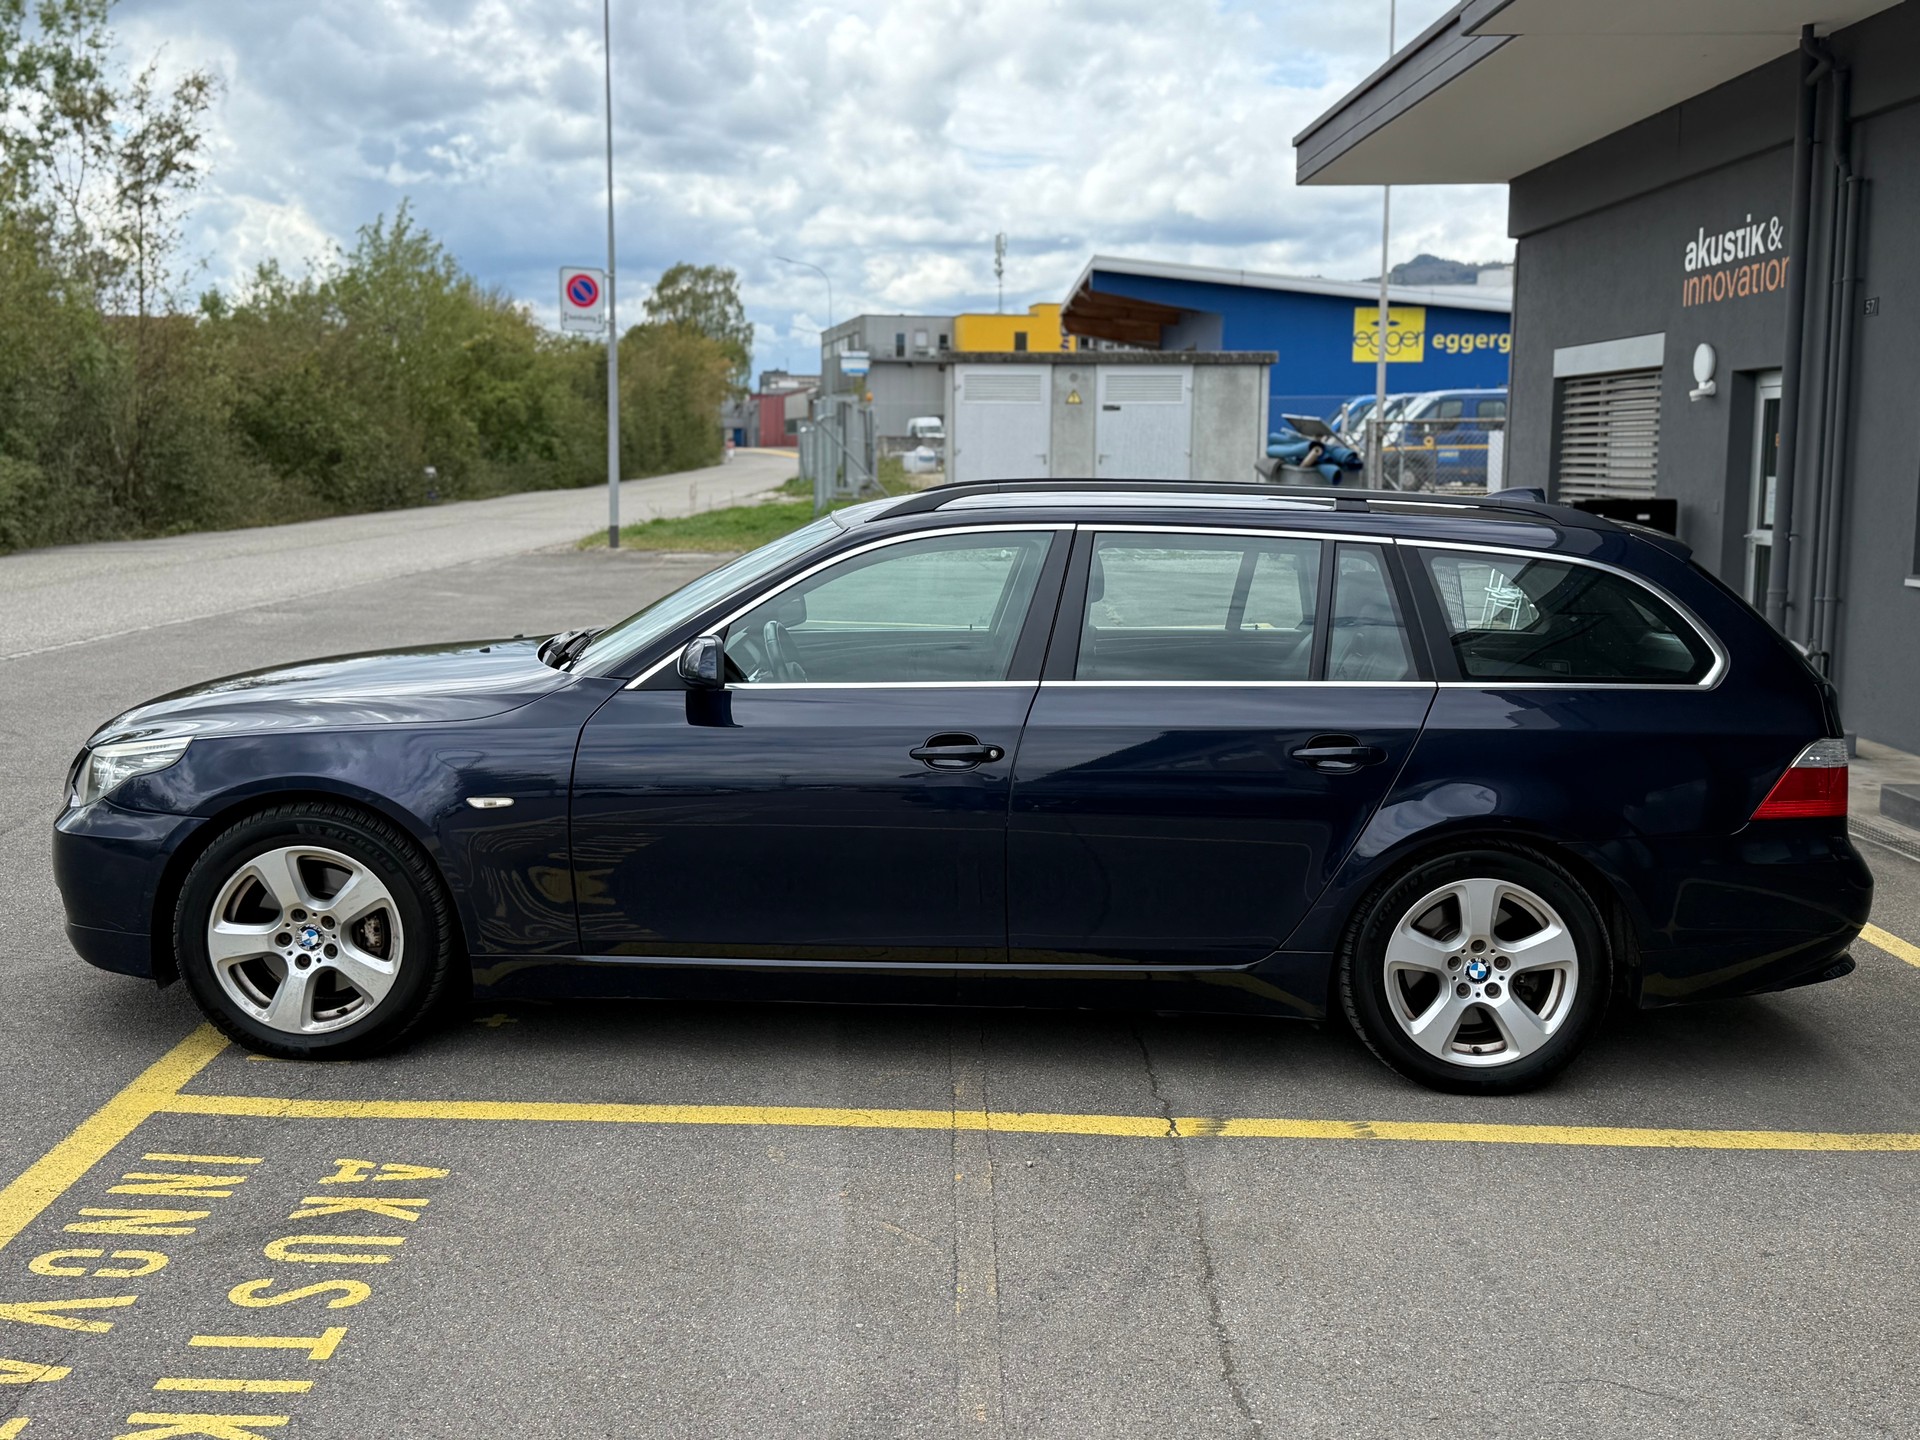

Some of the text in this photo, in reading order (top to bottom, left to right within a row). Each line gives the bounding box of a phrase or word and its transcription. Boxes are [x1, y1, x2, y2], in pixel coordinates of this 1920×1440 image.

[1684, 213, 1784, 272] akustik &
[1432, 333, 1511, 354] eggerg
[0, 1152, 265, 1440] INNOV
[112, 1158, 451, 1440] AKUSTIK
